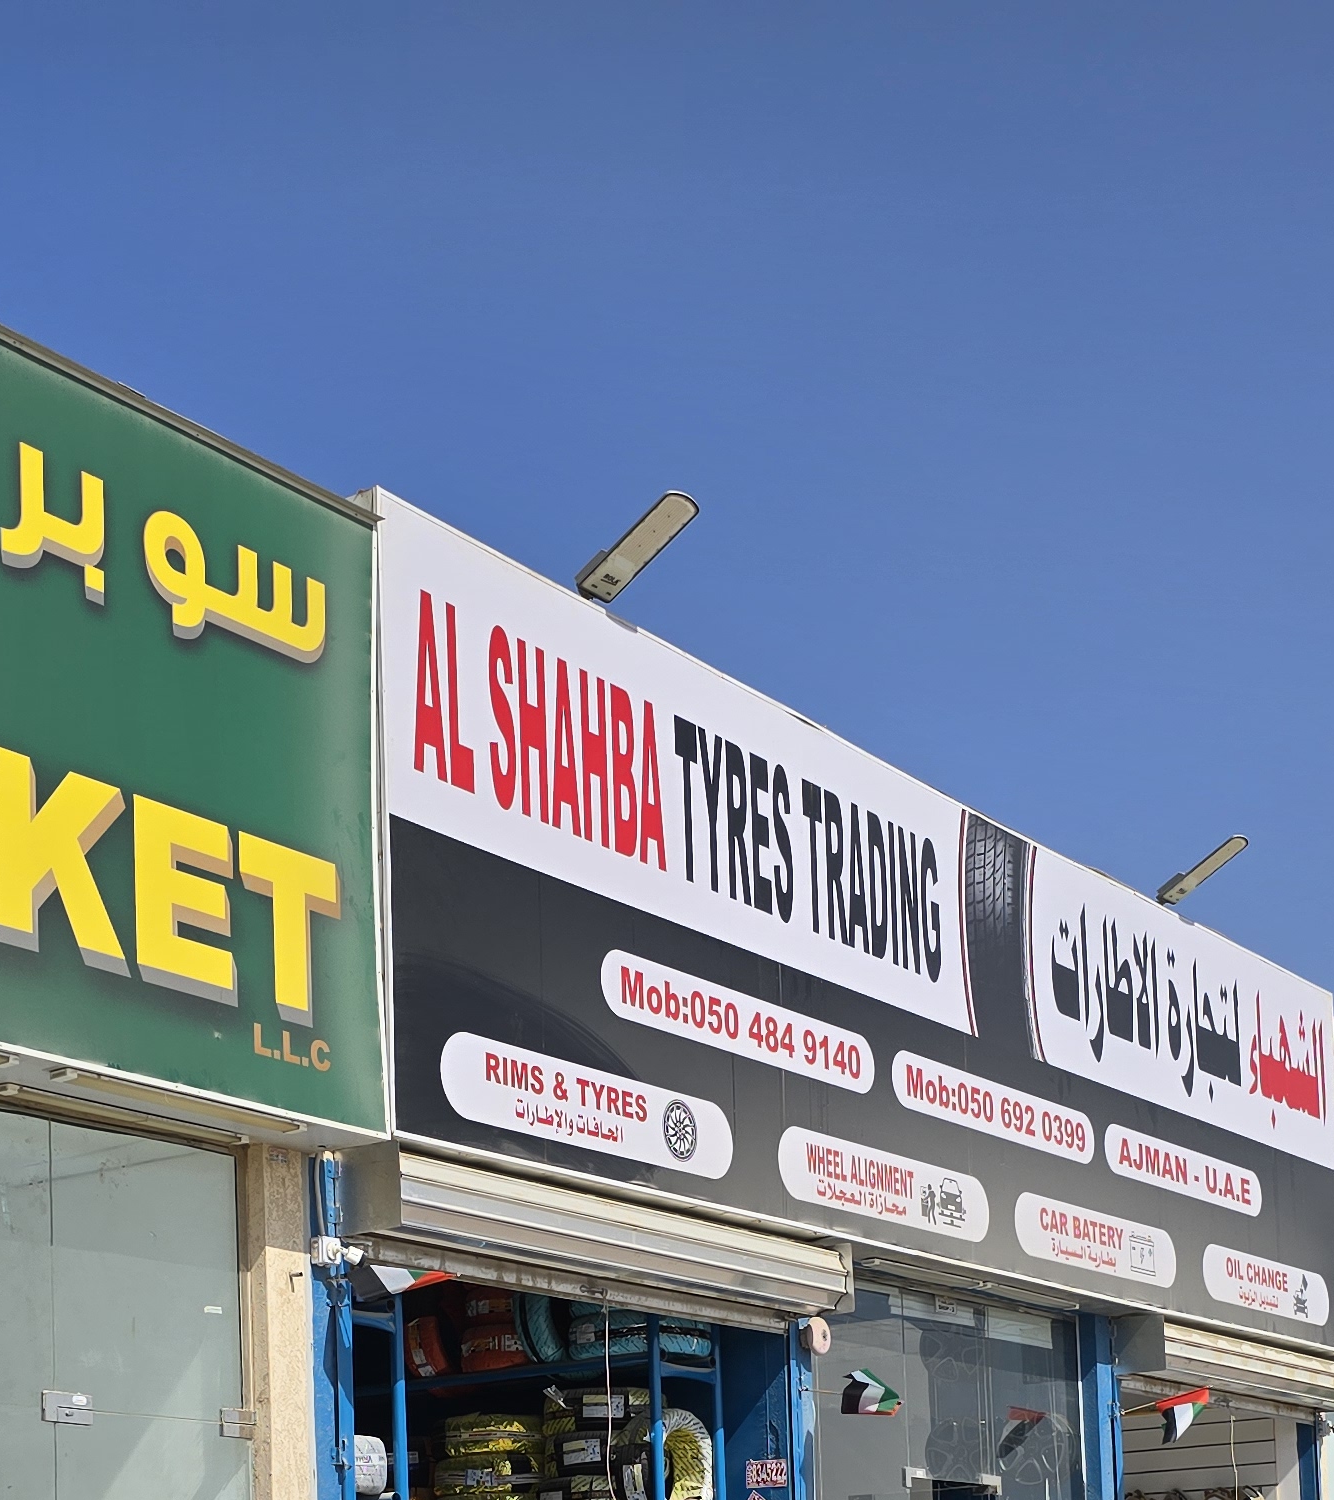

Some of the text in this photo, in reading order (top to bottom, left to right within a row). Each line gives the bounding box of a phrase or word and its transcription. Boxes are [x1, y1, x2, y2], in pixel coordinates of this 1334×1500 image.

[0, 442, 326, 664] سوبر
[414, 589, 941, 984] AL SHAHBA TYRES TRADING
[253, 1023, 331, 1071] L.L.C
[620, 966, 861, 1080] Mob:050 484 9140
[485, 1052, 648, 1122] RIMS & TYRES
[906, 1064, 1086, 1153] Mob:050 692 0399
[805, 1142, 914, 1199] WHEEL ALIGNMENT
[1119, 1137, 1188, 1187] AJMAN
[1205, 1165, 1252, 1206] U.A.E
[1039, 1207, 1124, 1250] CAR BATERY
[1226, 1256, 1289, 1292] OIL CHANGE
